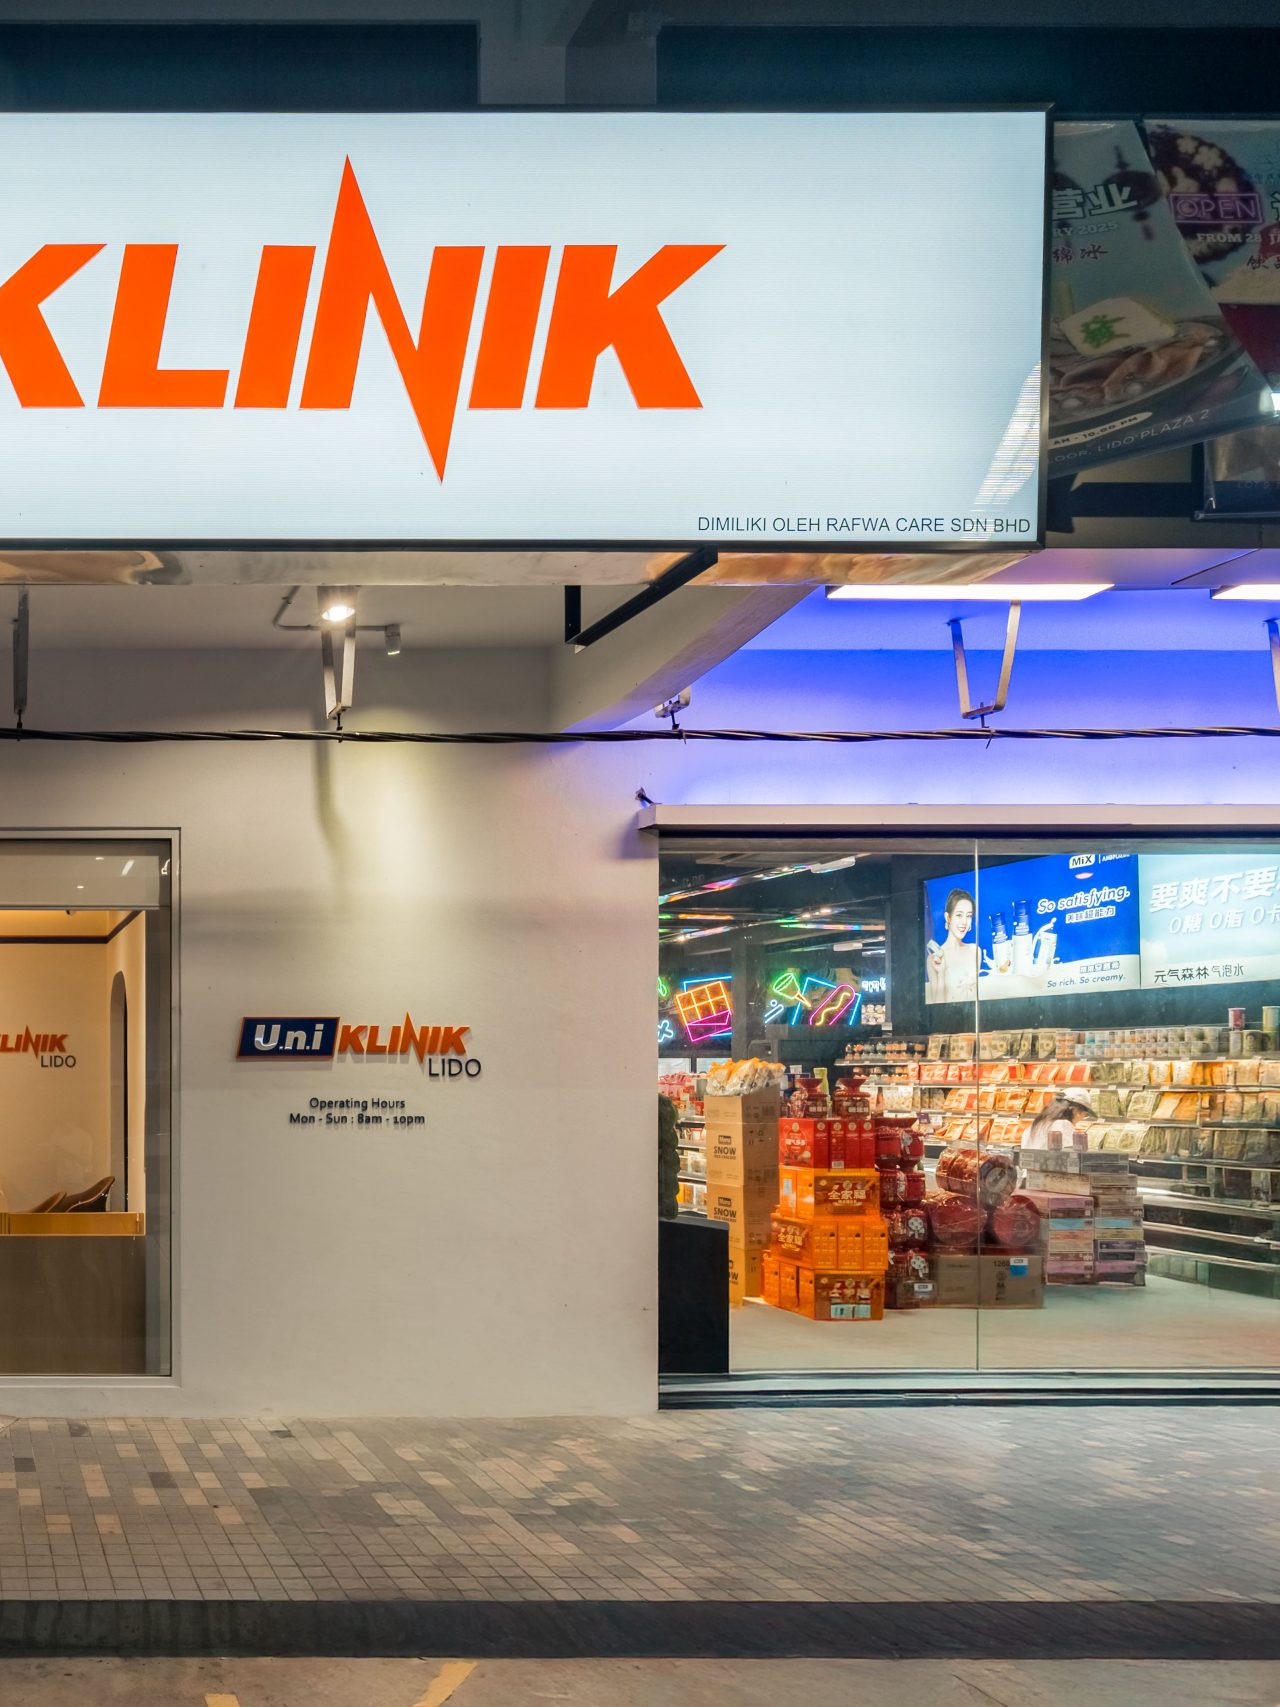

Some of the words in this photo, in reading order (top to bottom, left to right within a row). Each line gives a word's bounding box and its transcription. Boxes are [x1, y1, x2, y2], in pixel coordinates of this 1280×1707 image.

[1176, 198, 1256, 220] OPEN
[1078, 220, 1119, 236] 2025
[1196, 232, 1242, 244] FROM
[1245, 233, 1262, 244] 28
[1120, 416, 1138, 425] PM
[1097, 435, 1135, 452] LIDO
[1140, 414, 1195, 441] PLAZA
[1198, 408, 1210, 421] 2
[698, 517, 767, 532] DIMILIKI
[772, 517, 821, 532] OLEH
[826, 517, 890, 532] RAFWA
[895, 517, 945, 533] CARE
[950, 517, 988, 533] SDN
[993, 517, 1031, 533] BHD
[1149, 865, 1280, 914] 要爽不要
[1037, 898, 1056, 914] So
[1057, 885, 1131, 912] satisfying.
[1047, 980, 1057, 989] So
[1059, 977, 1077, 988] rich.
[1079, 975, 1091, 985] So
[1092, 972, 1126, 985] creamy.
[337, 1011, 470, 1064] KLINIK
[40, 1055, 77, 1069] LIDO
[428, 1058, 482, 1078] LIDO
[309, 1097, 368, 1111] Operating
[371, 1097, 406, 1109] Hours
[289, 1113, 315, 1124] Mon
[325, 1113, 348, 1124] Sun
[357, 1113, 383, 1124] 8am
[393, 1114, 425, 1127] 10pm
[713, 1145, 737, 1155] SNOW
[713, 1207, 737, 1218] SNOW
